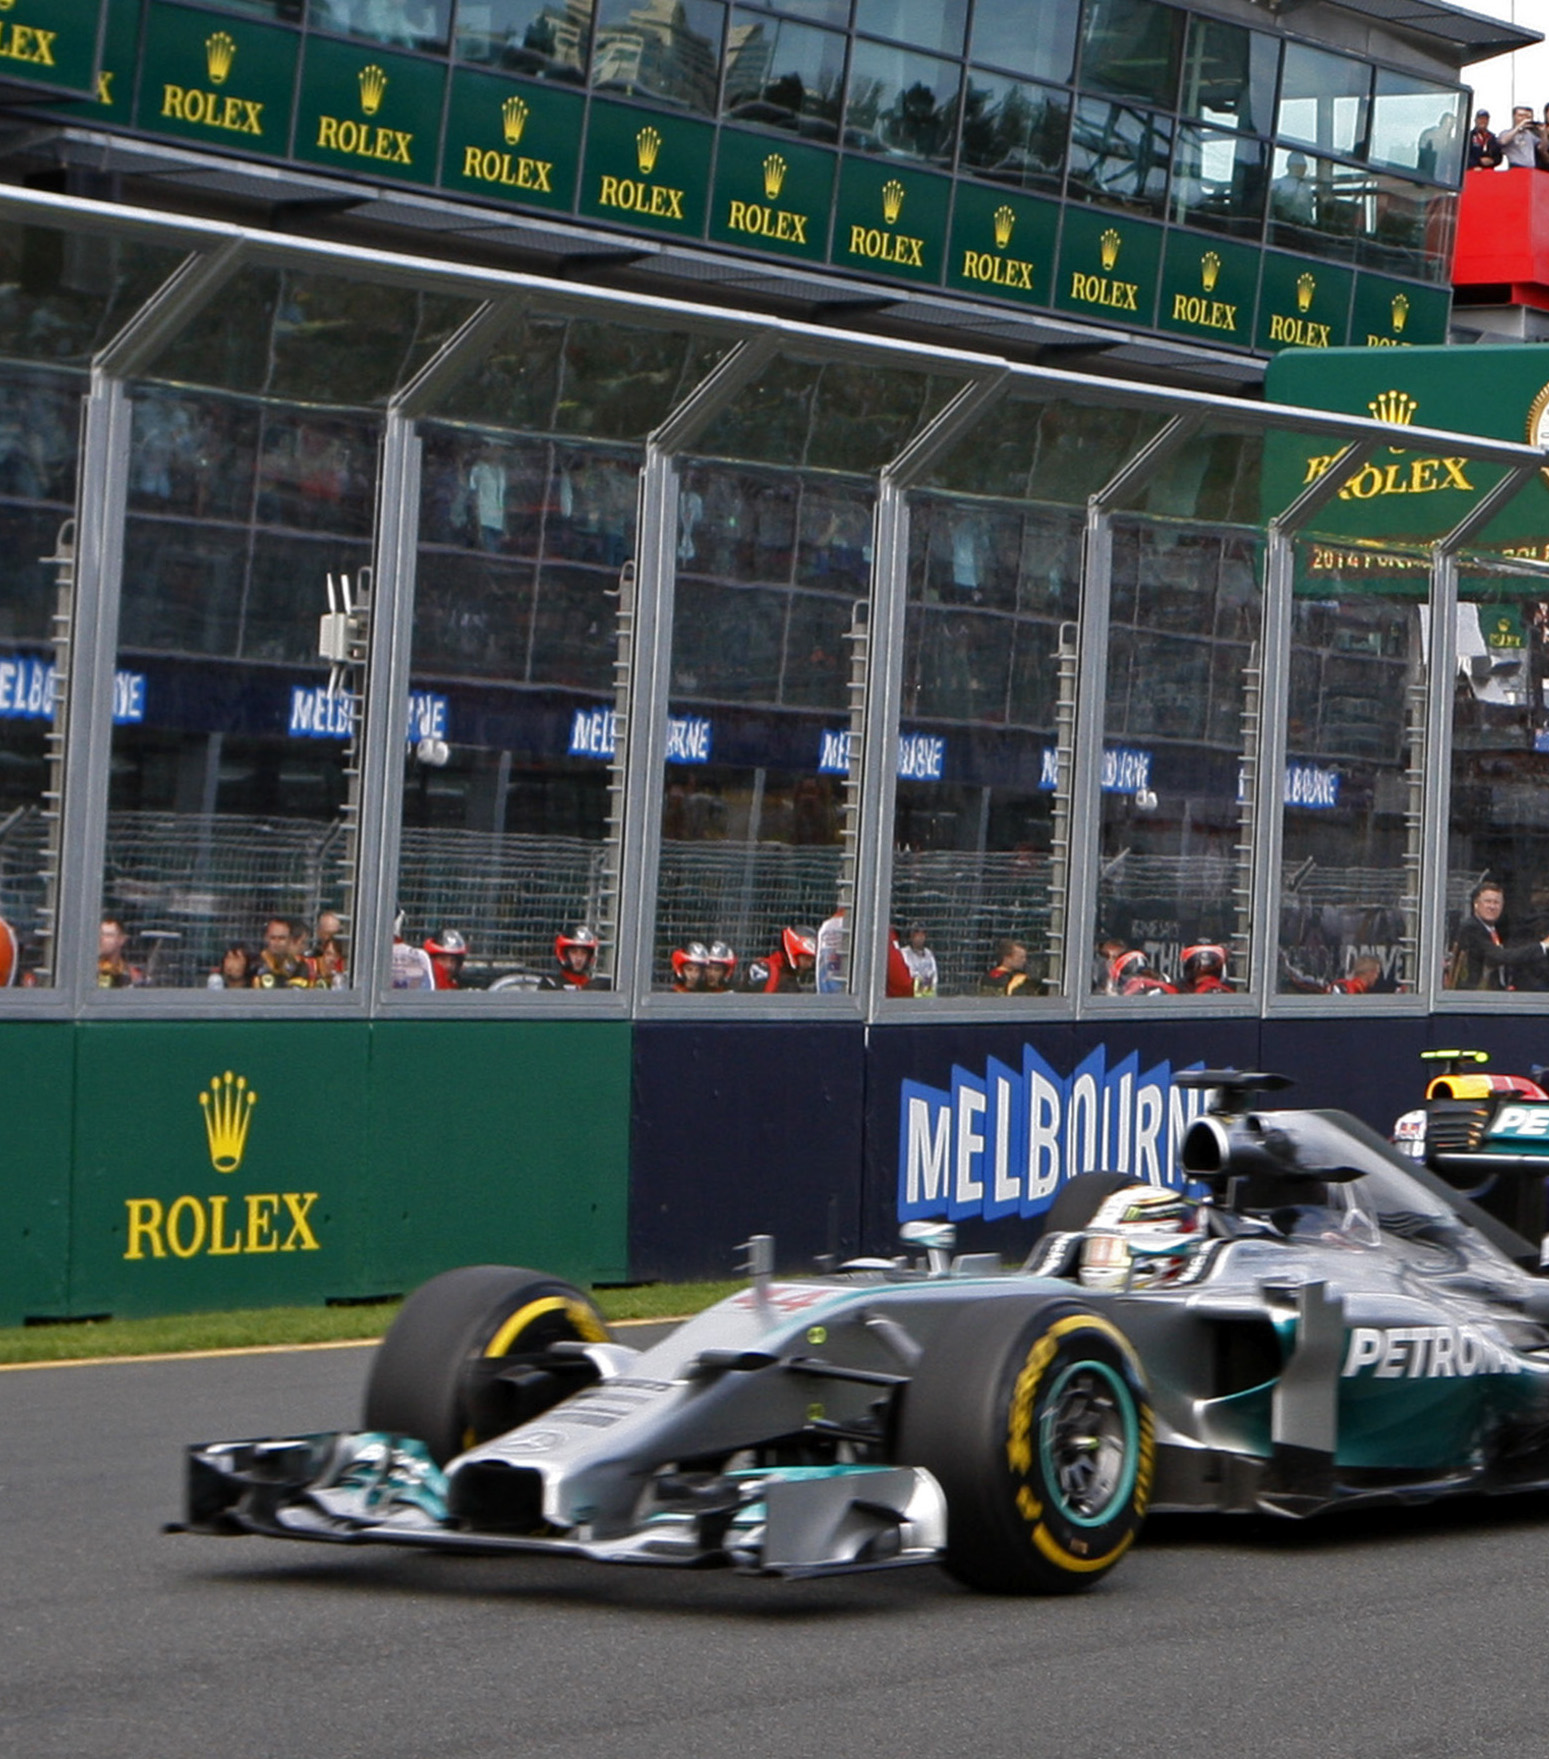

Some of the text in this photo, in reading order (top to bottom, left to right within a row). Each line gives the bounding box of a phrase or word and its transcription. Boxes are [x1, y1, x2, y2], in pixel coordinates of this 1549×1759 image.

[163, 85, 262, 134] ROLEX
[318, 112, 412, 164] ROLEX
[464, 142, 551, 192] ROLEX
[600, 176, 682, 219] ROLEX
[729, 197, 807, 242] ROLEX
[850, 226, 923, 266] ROLEX
[964, 251, 1032, 289] ROLEX
[1072, 273, 1137, 310] ROLEX
[1173, 295, 1236, 330] ROLEX
[1270, 314, 1330, 348] ROLEX
[906, 1070, 1216, 1204] MELBOURN
[124, 1192, 320, 1260] ROLEX
